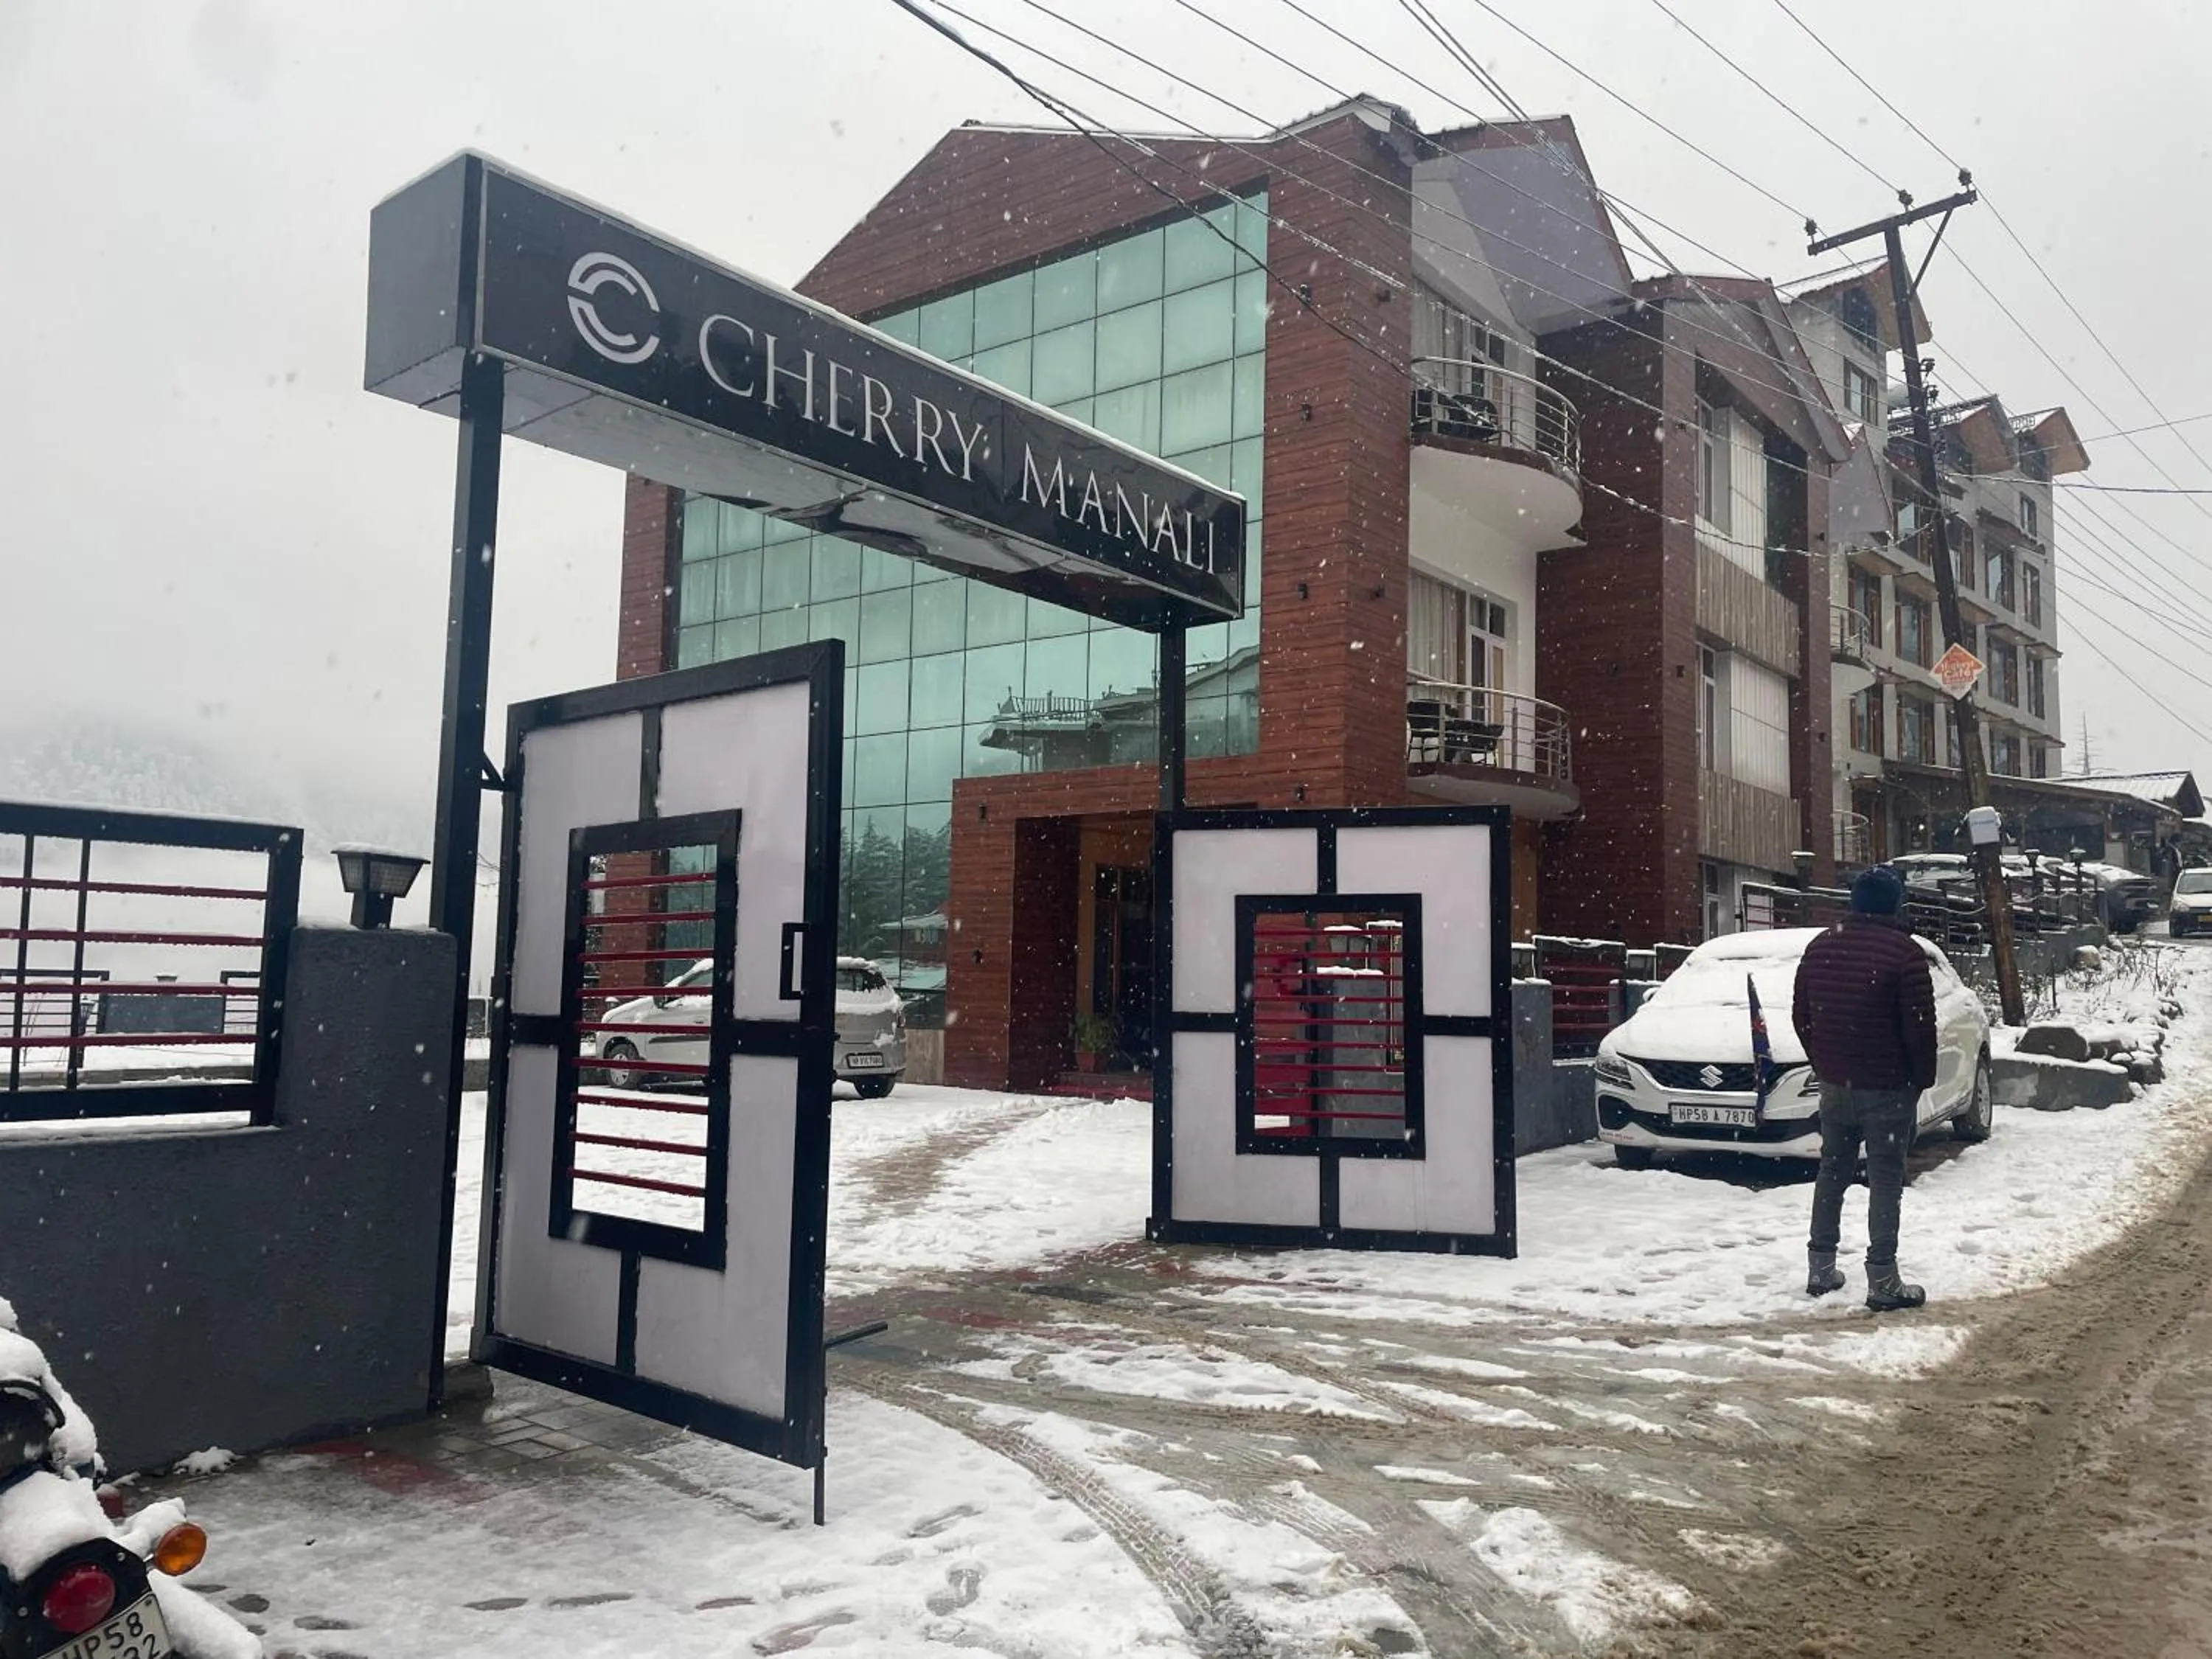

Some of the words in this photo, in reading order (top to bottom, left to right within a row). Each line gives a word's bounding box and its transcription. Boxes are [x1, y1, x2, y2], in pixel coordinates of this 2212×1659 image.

[698, 313, 987, 483] CHERRY
[1019, 442, 1217, 575] MANALI
[1678, 1108, 1709, 1121] HP58
